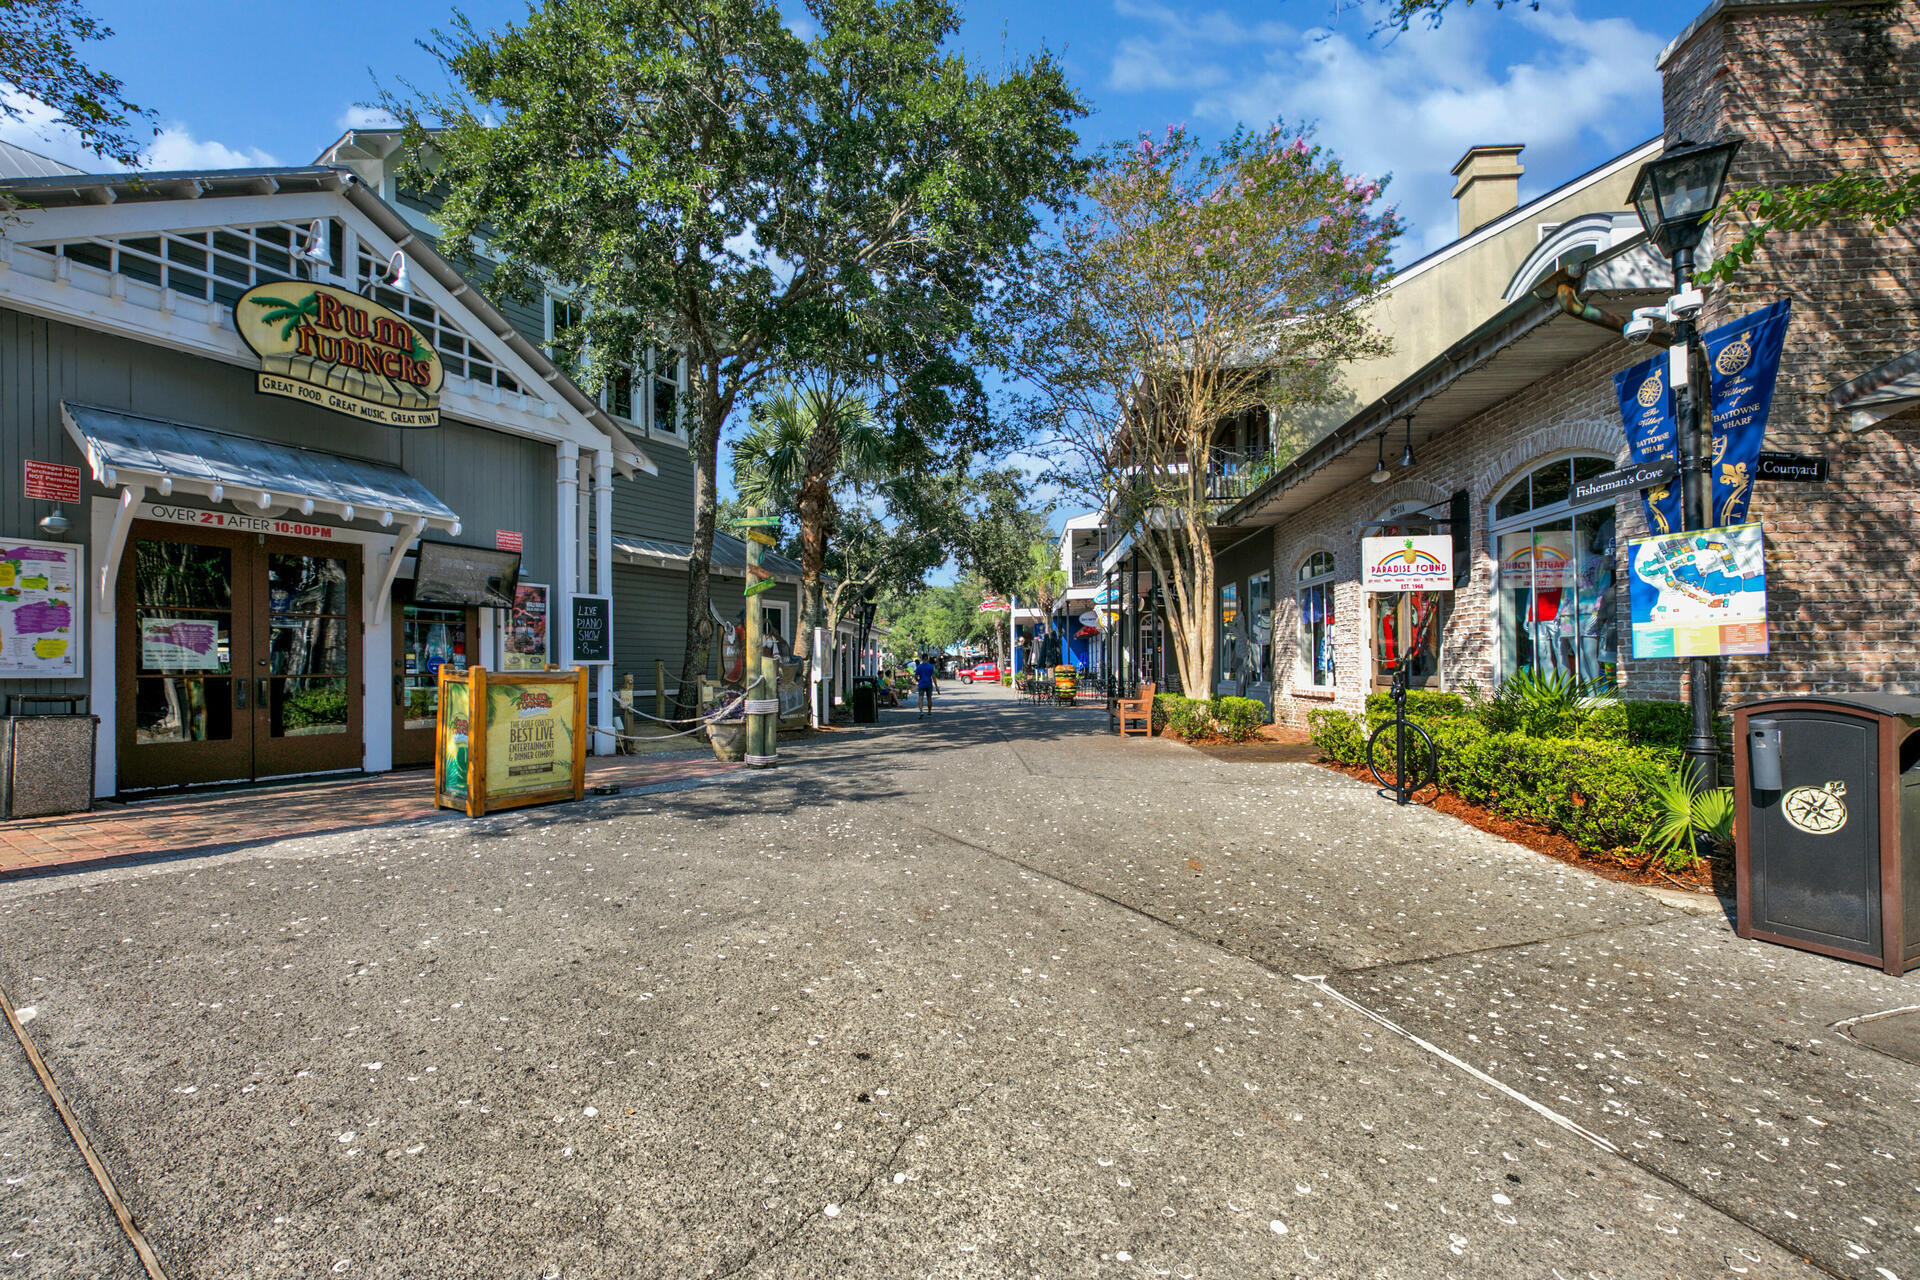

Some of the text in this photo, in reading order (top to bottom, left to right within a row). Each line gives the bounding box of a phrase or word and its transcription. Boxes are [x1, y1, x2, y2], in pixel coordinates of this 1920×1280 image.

[262, 377, 294, 393] GREAT
[329, 395, 357, 413] GREAT
[391, 412, 416, 424] GREAT
[1714, 402, 1760, 422] BAYTOWNE
[1722, 416, 1752, 430] WHARF
[1763, 460, 1818, 479] Courtyard
[1576, 469, 1663, 498] Fisherman's Cove
[152, 505, 332, 538] OVER 21 AFTER 10:00PM
[1371, 564, 1446, 573] PARADISE FOUND
[578, 605, 598, 616] LIVE
[576, 618, 602, 629] PIANO
[578, 630, 600, 641] SHOW
[510, 726, 554, 743] BEST LIVE
[509, 741, 554, 752] ENTERTAINMENT
[514, 752, 534, 760] DINNER
